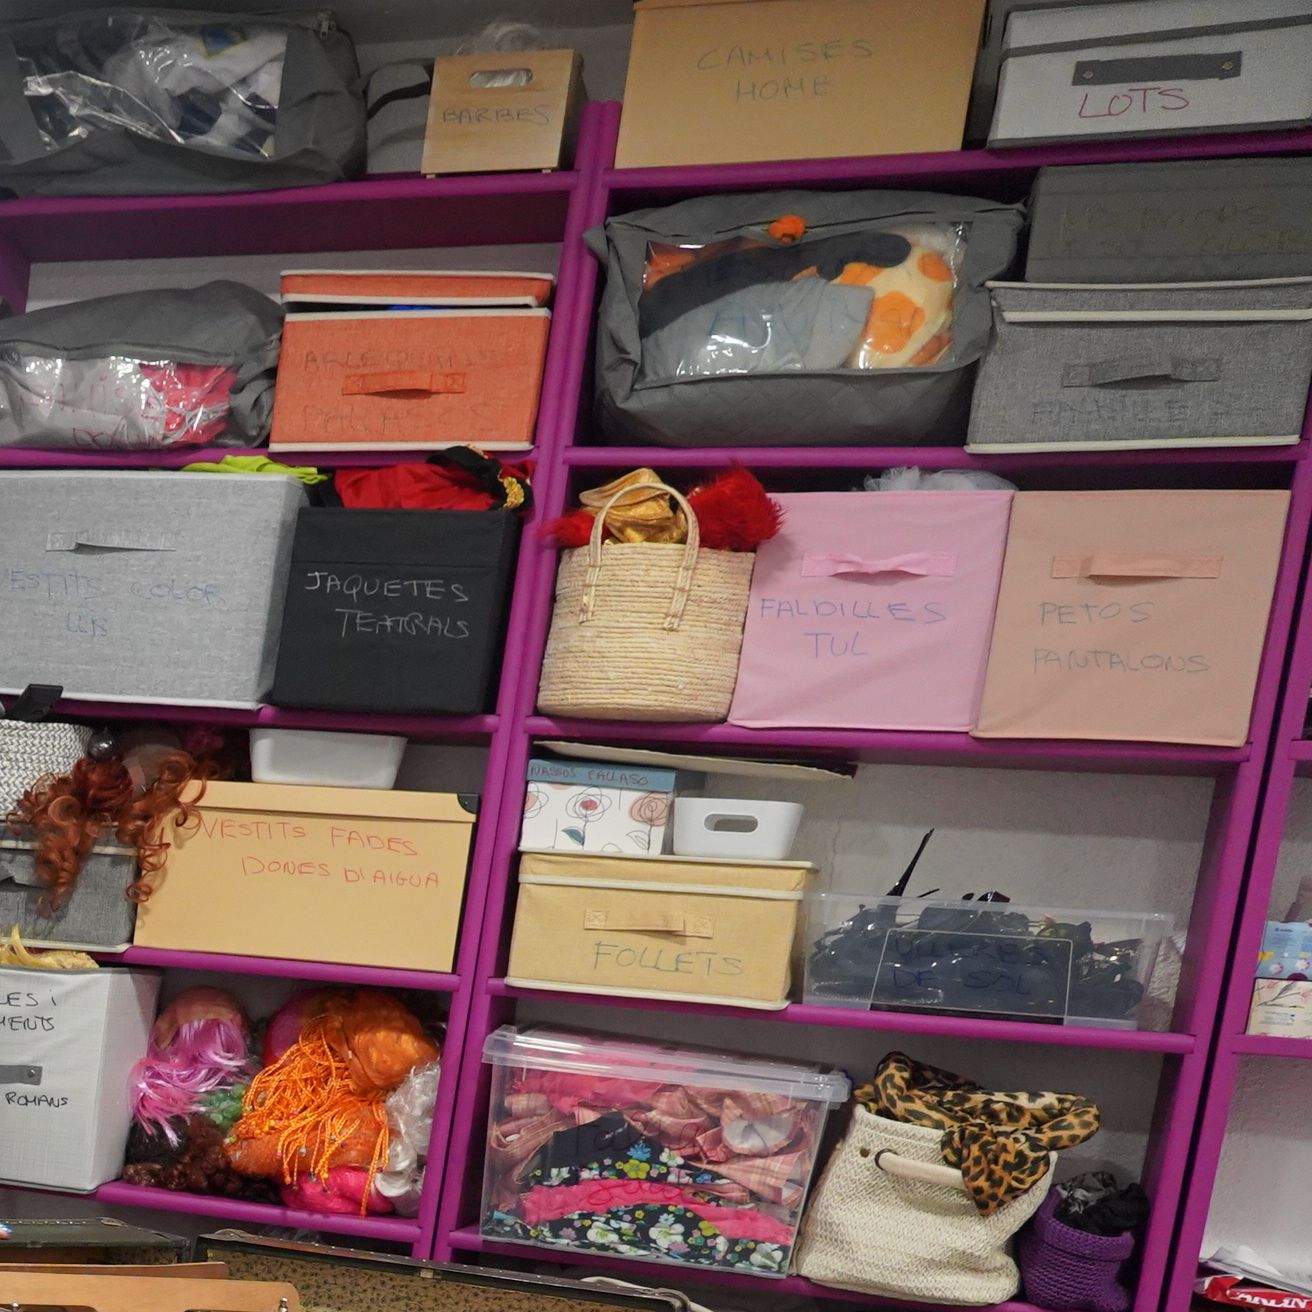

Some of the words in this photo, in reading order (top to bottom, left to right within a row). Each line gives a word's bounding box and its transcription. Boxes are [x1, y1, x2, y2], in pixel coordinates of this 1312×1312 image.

[697, 40, 872, 70] CAMISES
[736, 78, 829, 102] HOME
[1078, 87, 1190, 119] LOTS
[305, 571, 469, 602] JAQUETES
[760, 599, 948, 624] FALDILLES
[1040, 601, 1155, 626] PETOS
[804, 631, 870, 658] TUL
[201, 818, 306, 840] VESTITS
[330, 825, 419, 856] FADES
[242, 856, 331, 877] DONES
[593, 941, 746, 977] FOLLETS
[5, 1091, 69, 1108] ROMANS
